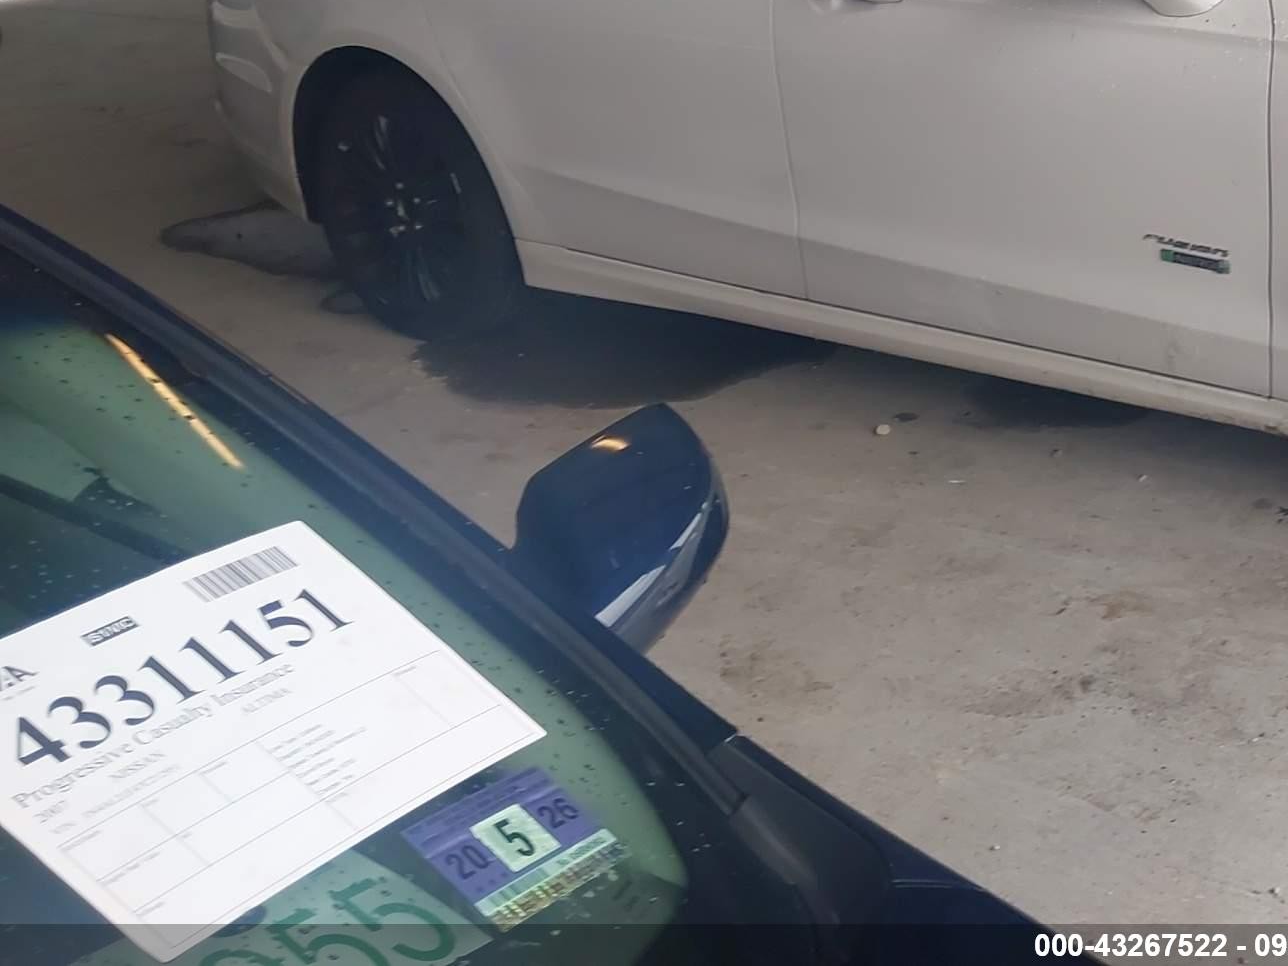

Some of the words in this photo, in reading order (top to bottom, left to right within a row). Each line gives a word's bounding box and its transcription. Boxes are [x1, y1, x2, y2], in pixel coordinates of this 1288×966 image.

[11, 743, 134, 809] Progressive
[132, 703, 214, 745] Casualty
[210, 664, 294, 707] Insurance
[17, 589, 354, 765] 43311151
[445, 845, 489, 880] 20
[493, 818, 535, 857] 5
[536, 797, 580, 830] 26
